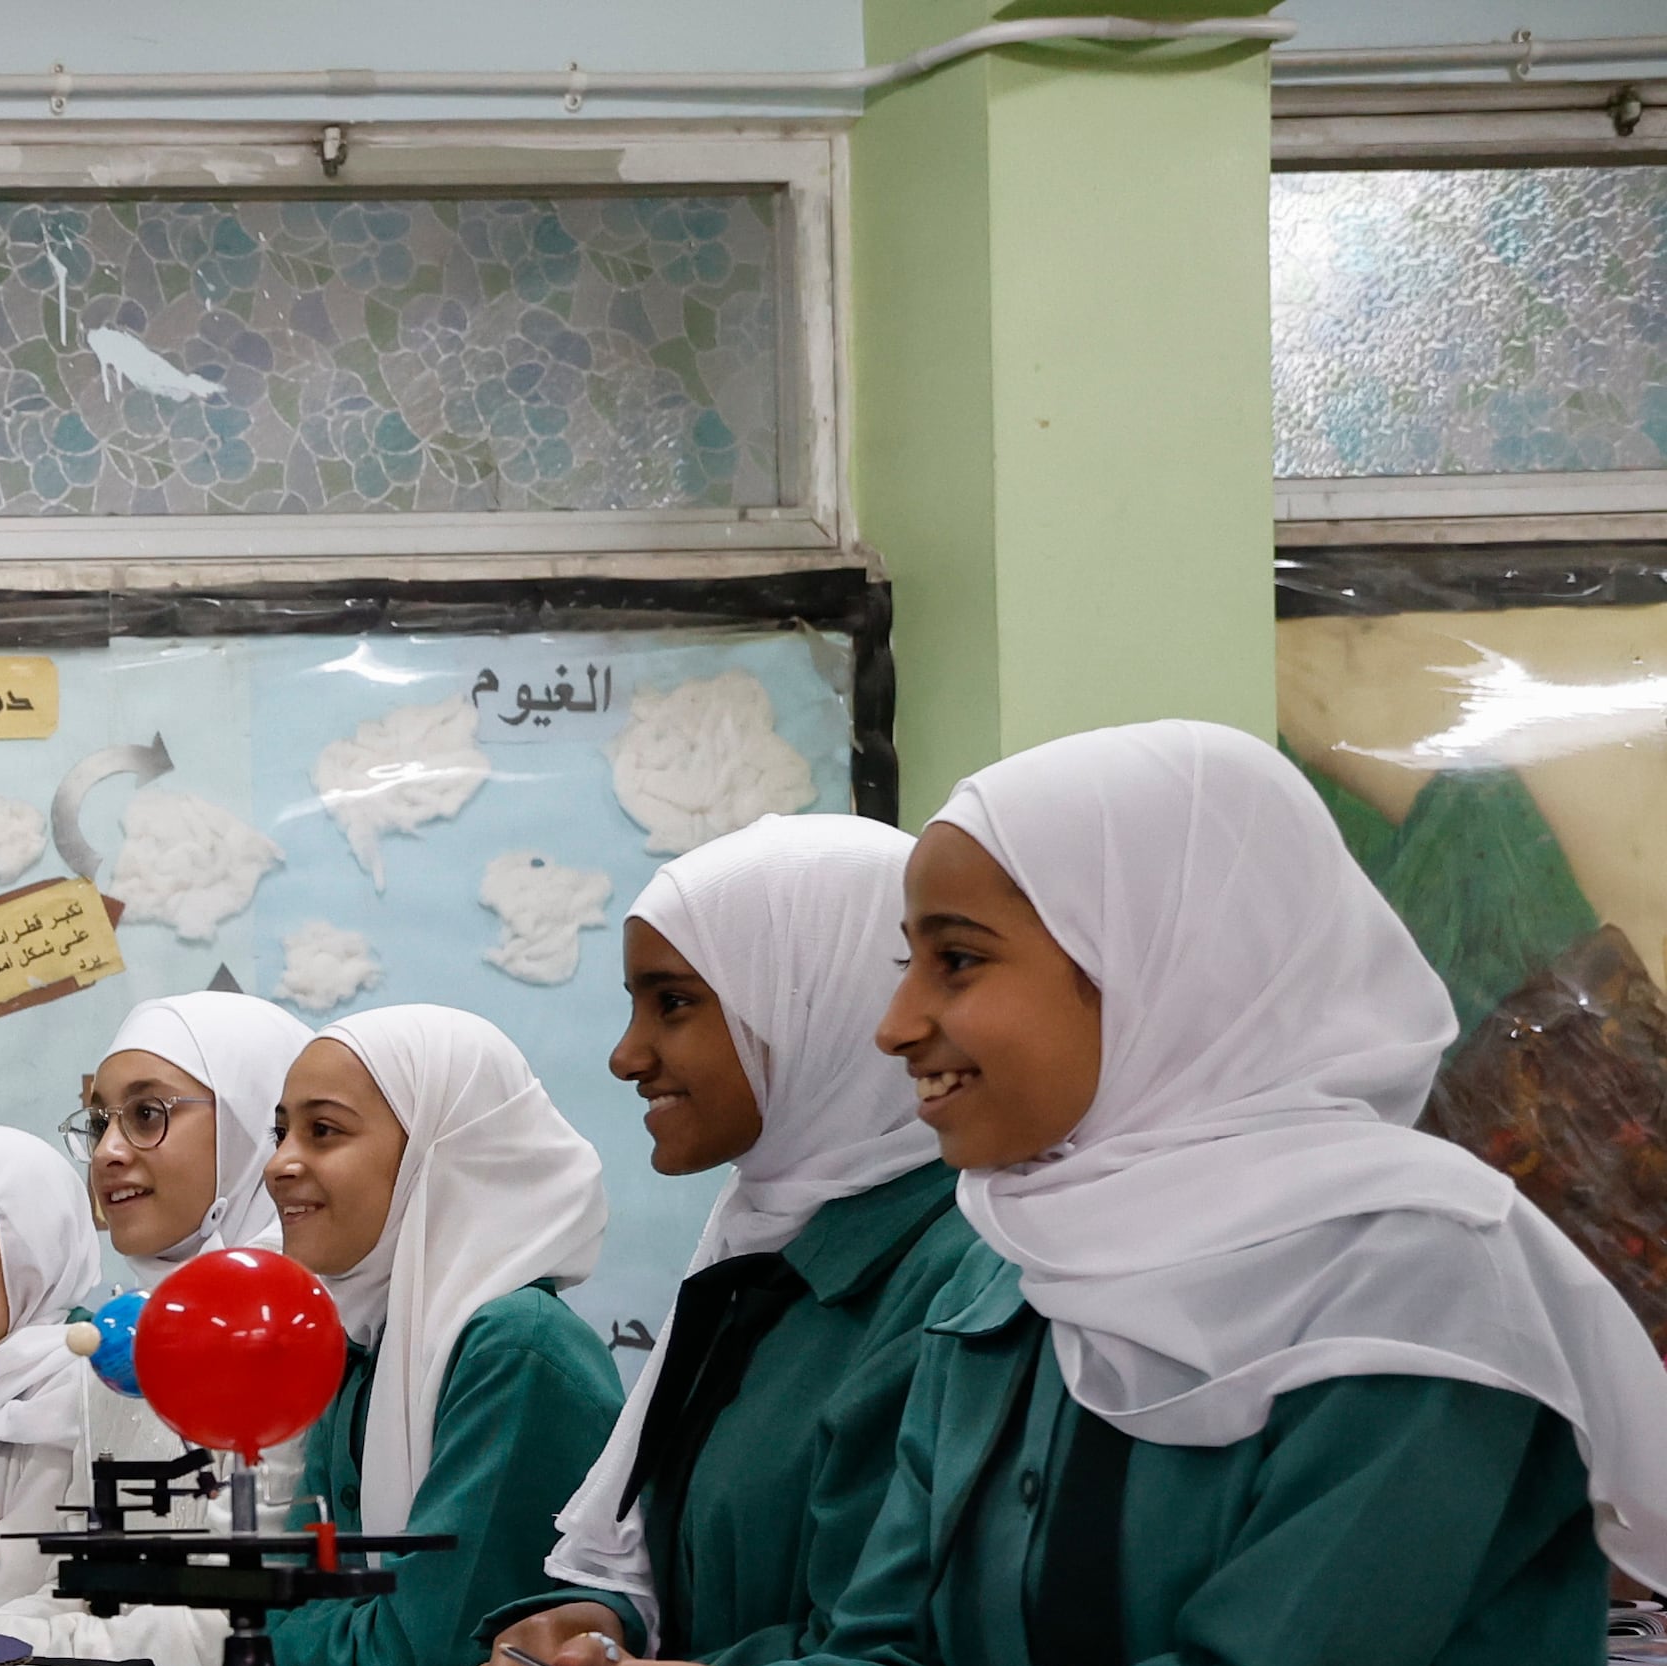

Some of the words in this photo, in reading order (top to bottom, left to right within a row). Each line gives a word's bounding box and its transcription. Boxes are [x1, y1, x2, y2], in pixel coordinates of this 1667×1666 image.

[471, 662, 612, 727] الغيوم
[18, 939, 55, 968] شكل
[59, 929, 90, 957] على
